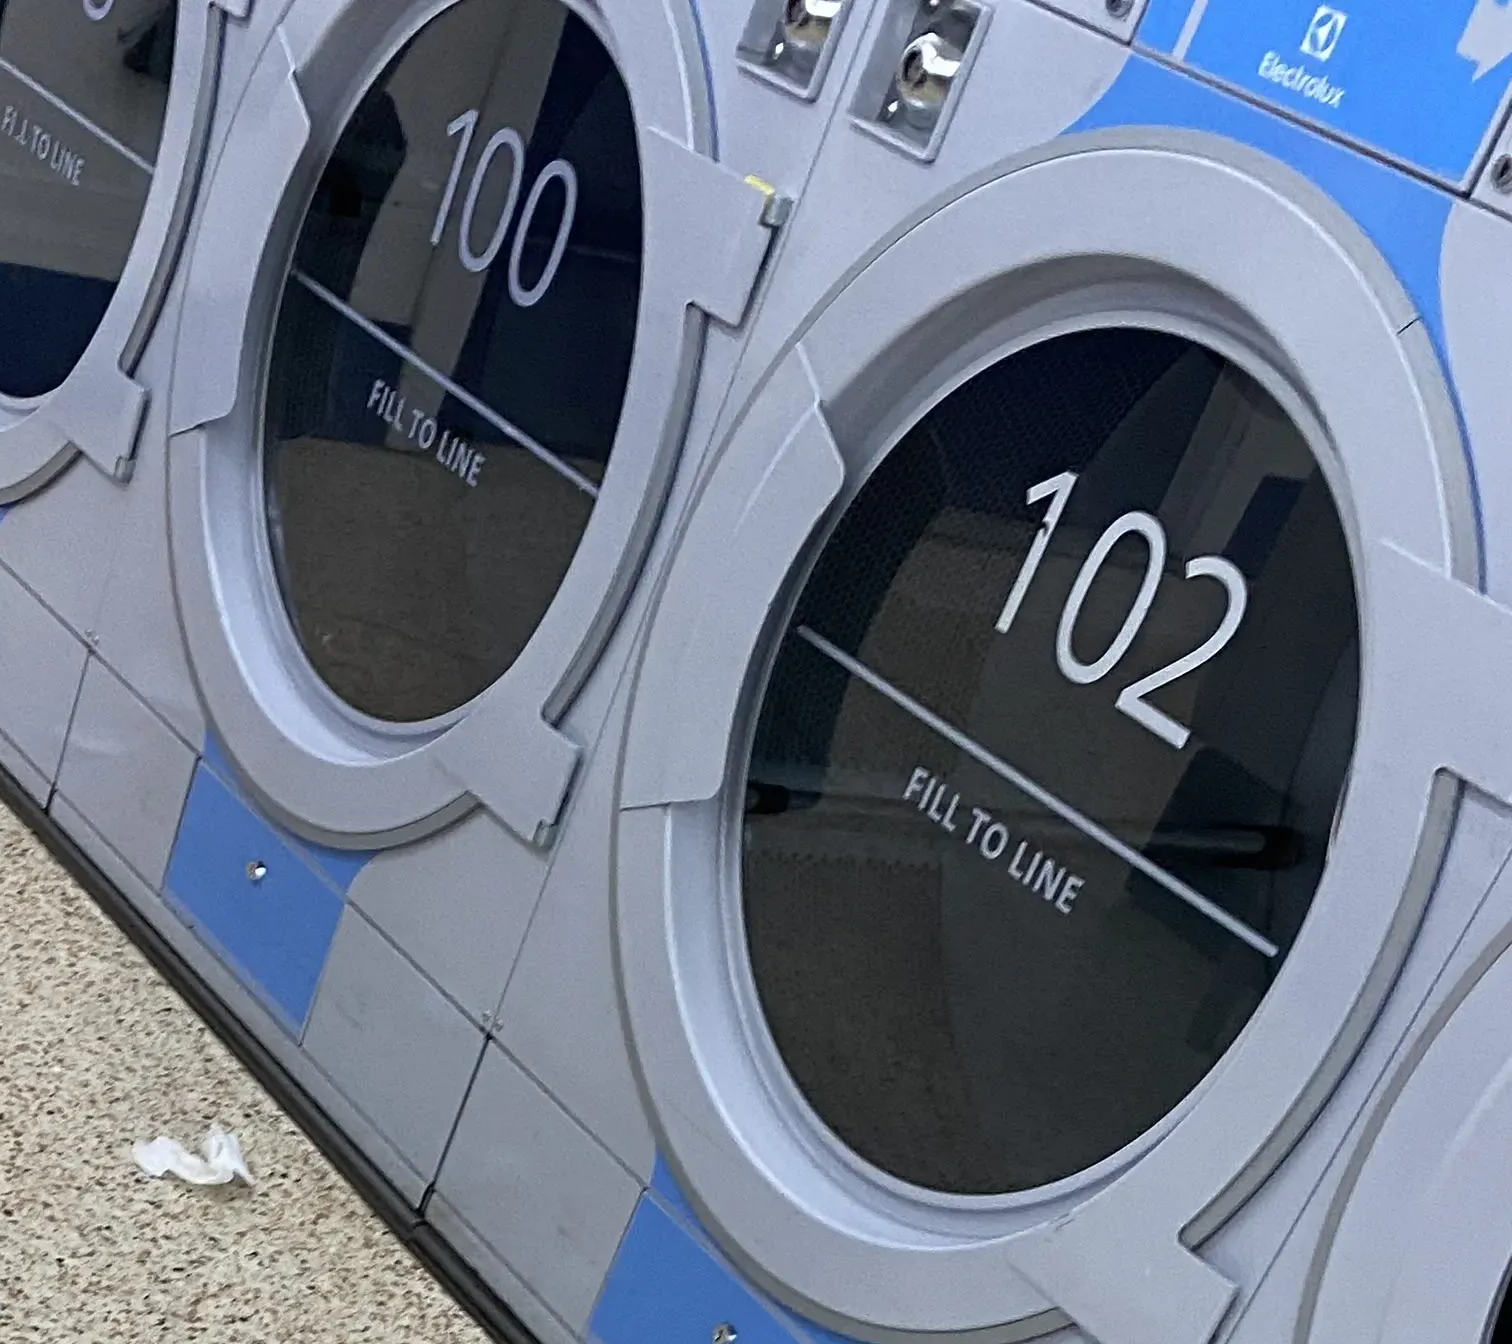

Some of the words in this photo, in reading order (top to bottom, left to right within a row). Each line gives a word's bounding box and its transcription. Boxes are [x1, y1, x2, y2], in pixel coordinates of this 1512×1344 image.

[1258, 50, 1345, 109] Electrolux
[30, 125, 51, 160] TO
[50, 140, 85, 186] LINE
[430, 108, 578, 307] 100
[367, 378, 407, 432] FILL
[407, 408, 437, 449] TO
[436, 429, 487, 488] LINE
[994, 469, 1248, 750] 102
[902, 765, 961, 833] FILL
[965, 806, 1010, 860] TO
[1007, 839, 1086, 915] LINE
